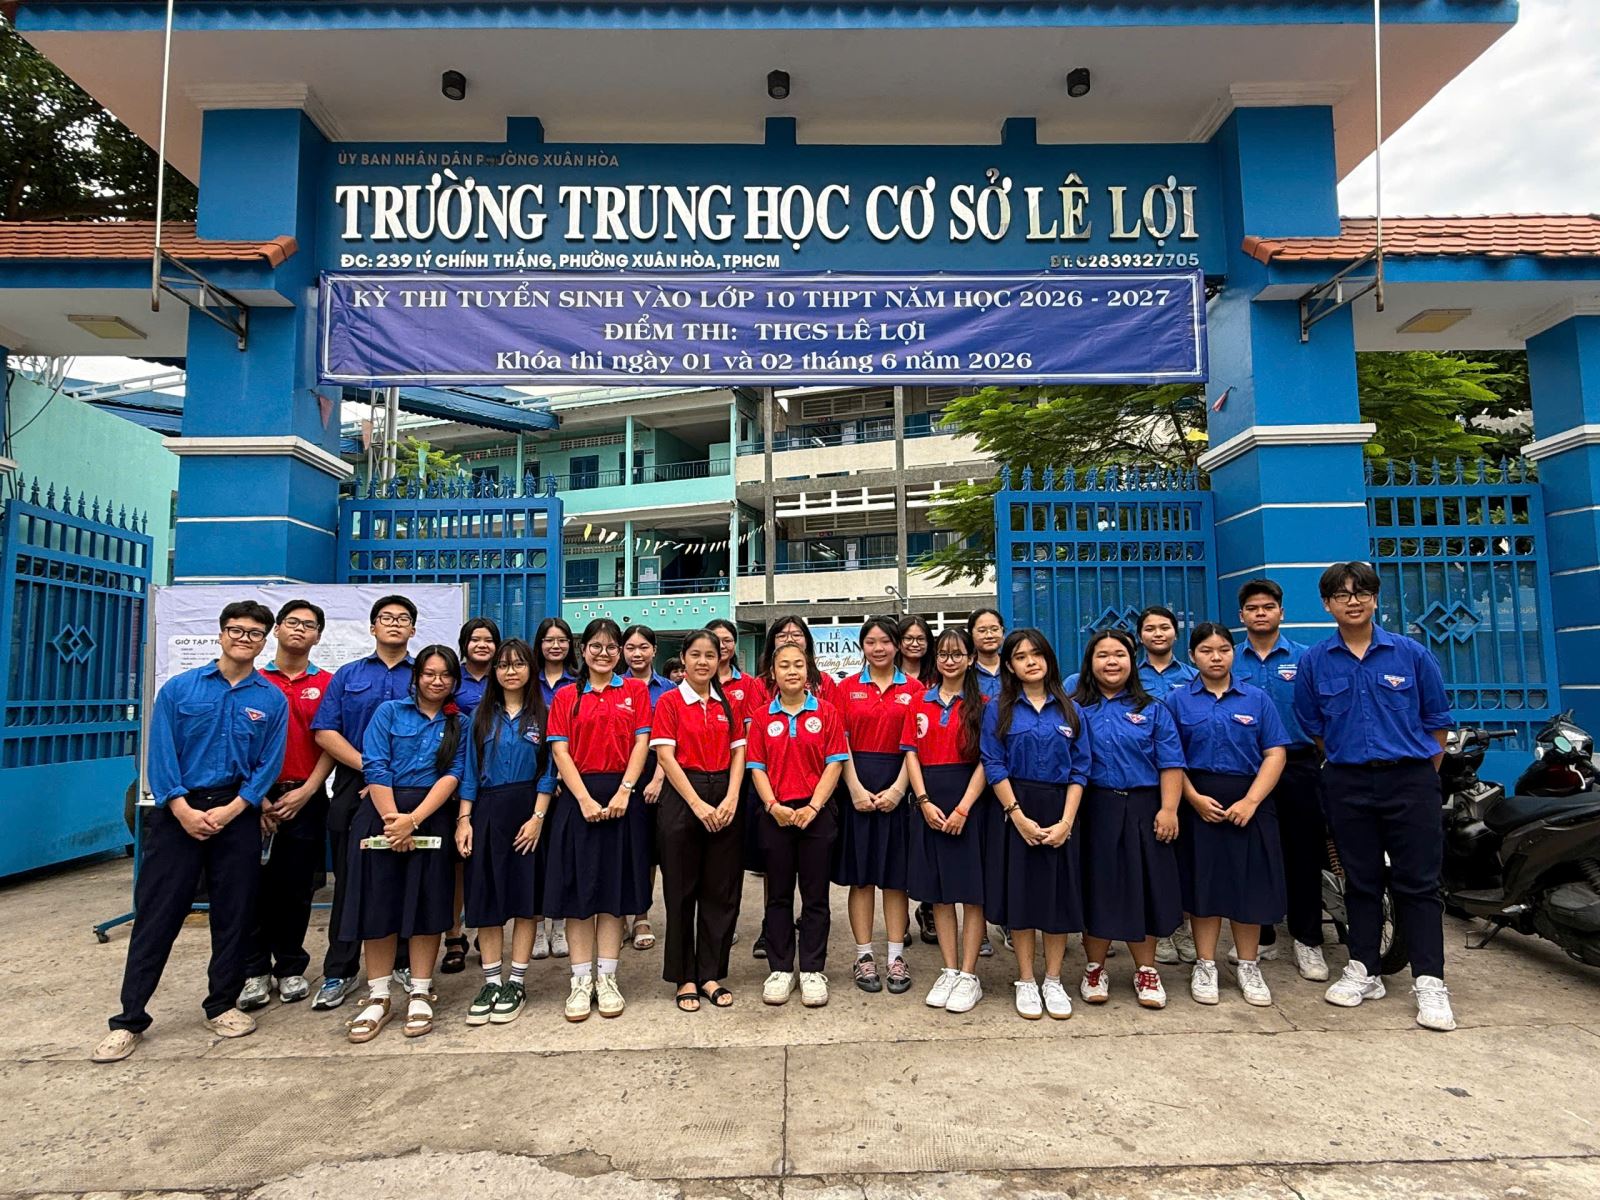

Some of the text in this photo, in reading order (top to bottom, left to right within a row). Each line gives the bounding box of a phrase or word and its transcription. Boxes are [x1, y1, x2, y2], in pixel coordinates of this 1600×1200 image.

[361, 153, 391, 165] BAN
[394, 150, 437, 165] NHÂN
[441, 150, 472, 166] DÂN
[476, 149, 539, 166] PƯỜNG
[543, 151, 583, 166] XUÂN
[587, 150, 619, 166] HÒA
[335, 167, 1200, 251] TRƯỜNG TRUNG HỌC CƠ SỞ LÊ LỢI
[340, 248, 780, 270] ĐC: 239 LÝ CHÍNH THẮNG, PHƯỜNG XUÂN HÒA, TPHCM
[1076, 253, 1200, 268] 02839327705
[352, 285, 390, 308] KỲ
[399, 290, 447, 308] THI
[456, 281, 550, 308] TUYỂN
[559, 290, 624, 308] SINH
[632, 285, 692, 308] VÀO
[700, 285, 755, 308] LỚP
[765, 290, 795, 308] 10
[803, 290, 877, 308] THPT
[884, 286, 945, 308] NĂM
[953, 290, 1011, 312] HỌC
[1019, 290, 1083, 307] 2026
[1107, 289, 1170, 307] 2027
[604, 314, 926, 345] ĐIỂM THI: THCS LÊ LỢI
[496, 350, 1033, 374] Khóa thi ngày 01 và 02 tháng 6 năm 2026
[816, 637, 862, 653] TRI ÂN
